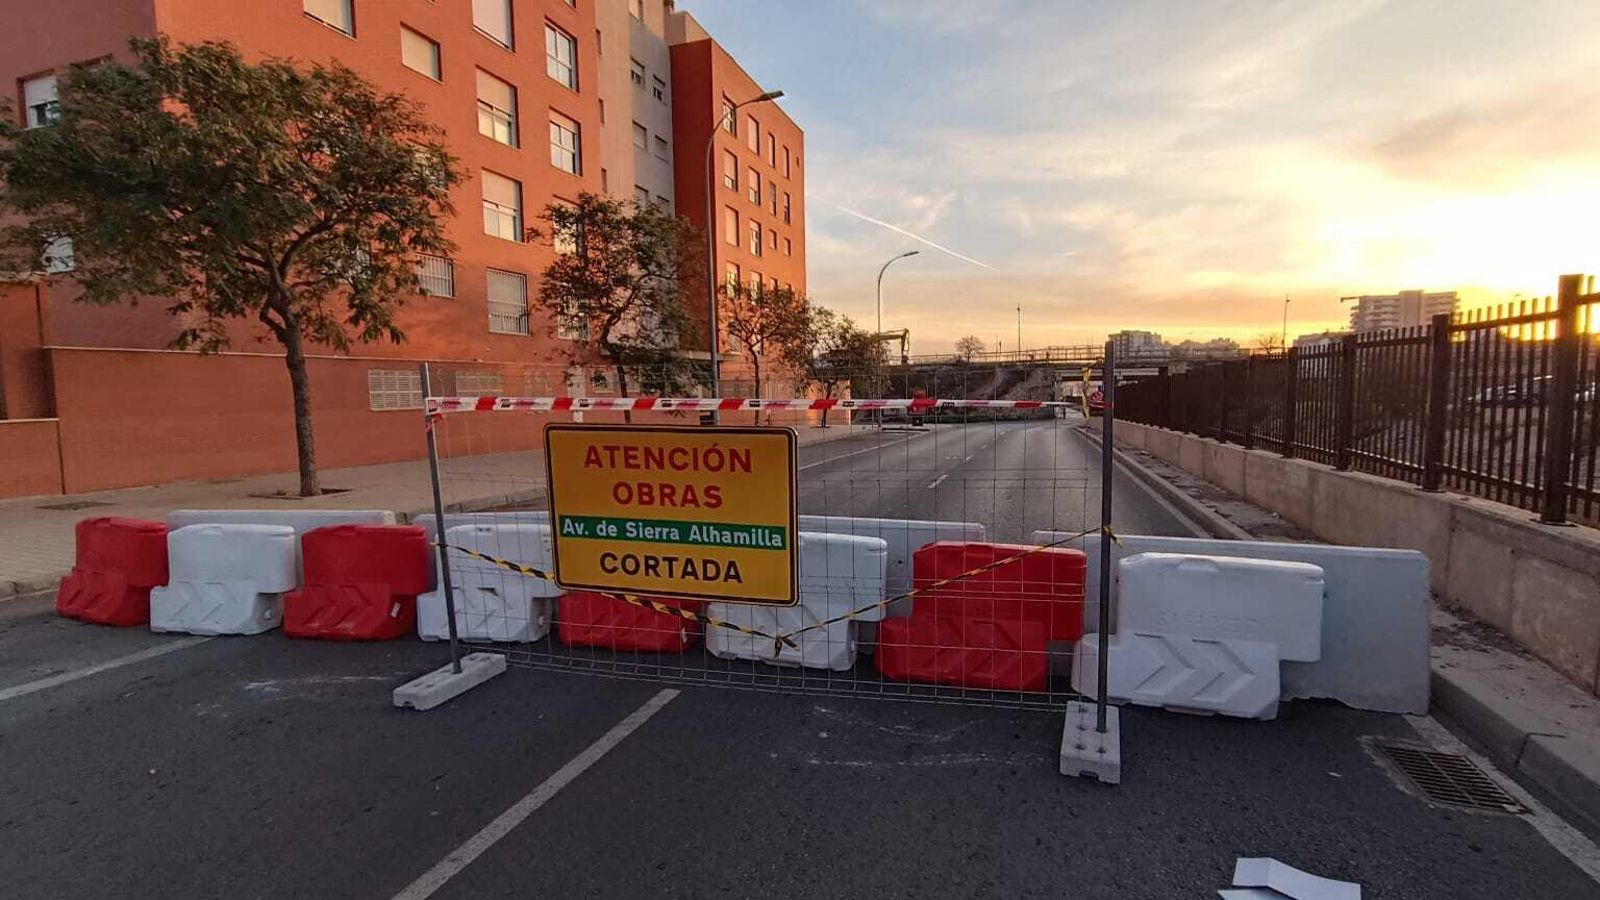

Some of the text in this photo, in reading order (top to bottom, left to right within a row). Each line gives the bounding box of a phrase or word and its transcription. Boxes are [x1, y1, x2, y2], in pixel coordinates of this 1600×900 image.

[584, 443, 752, 473] ATENCIÓN
[612, 481, 723, 509] OBRAS
[562, 517, 783, 547] Av. de Sierra Alhamilla
[599, 552, 743, 584] CORTADA
